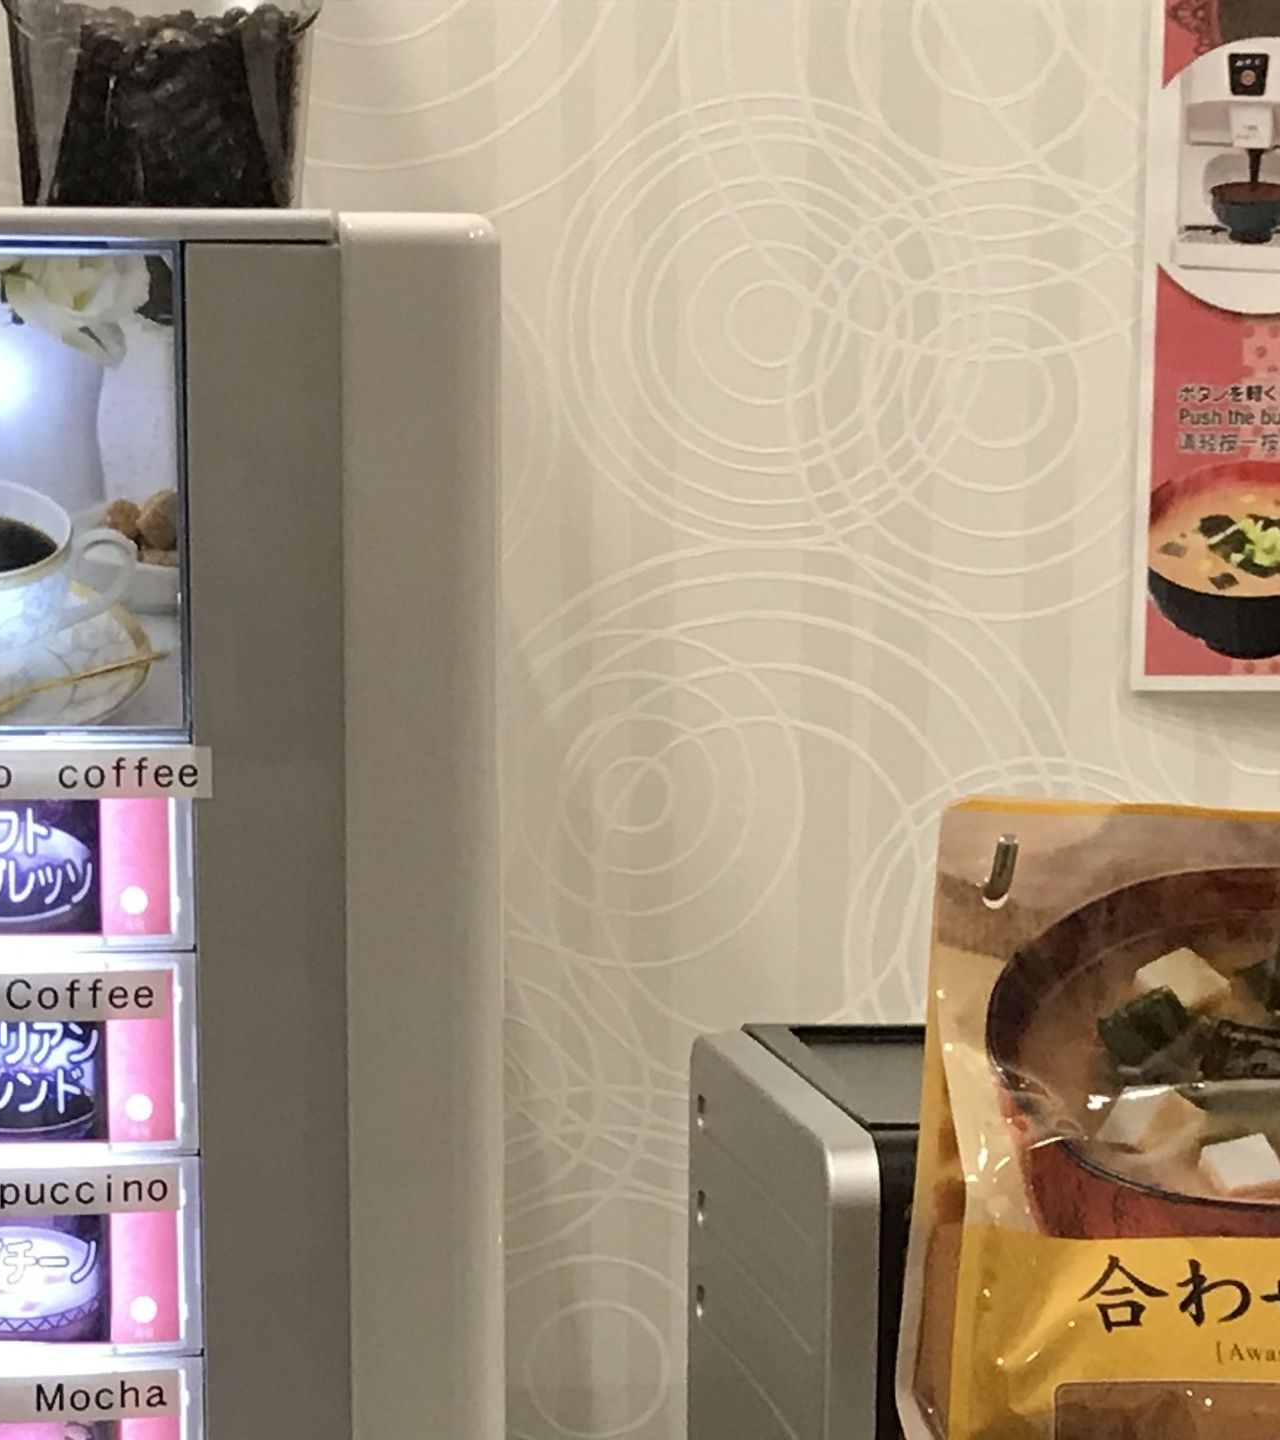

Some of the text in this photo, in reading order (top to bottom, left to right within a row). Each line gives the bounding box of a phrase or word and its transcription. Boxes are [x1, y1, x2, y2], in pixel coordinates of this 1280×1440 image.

[1179, 409, 1221, 425] Push
[1228, 409, 1255, 425] the
[58, 757, 199, 789] coffee
[5, 979, 154, 1010] Coffee
[35, 1380, 168, 1412] Mocha
